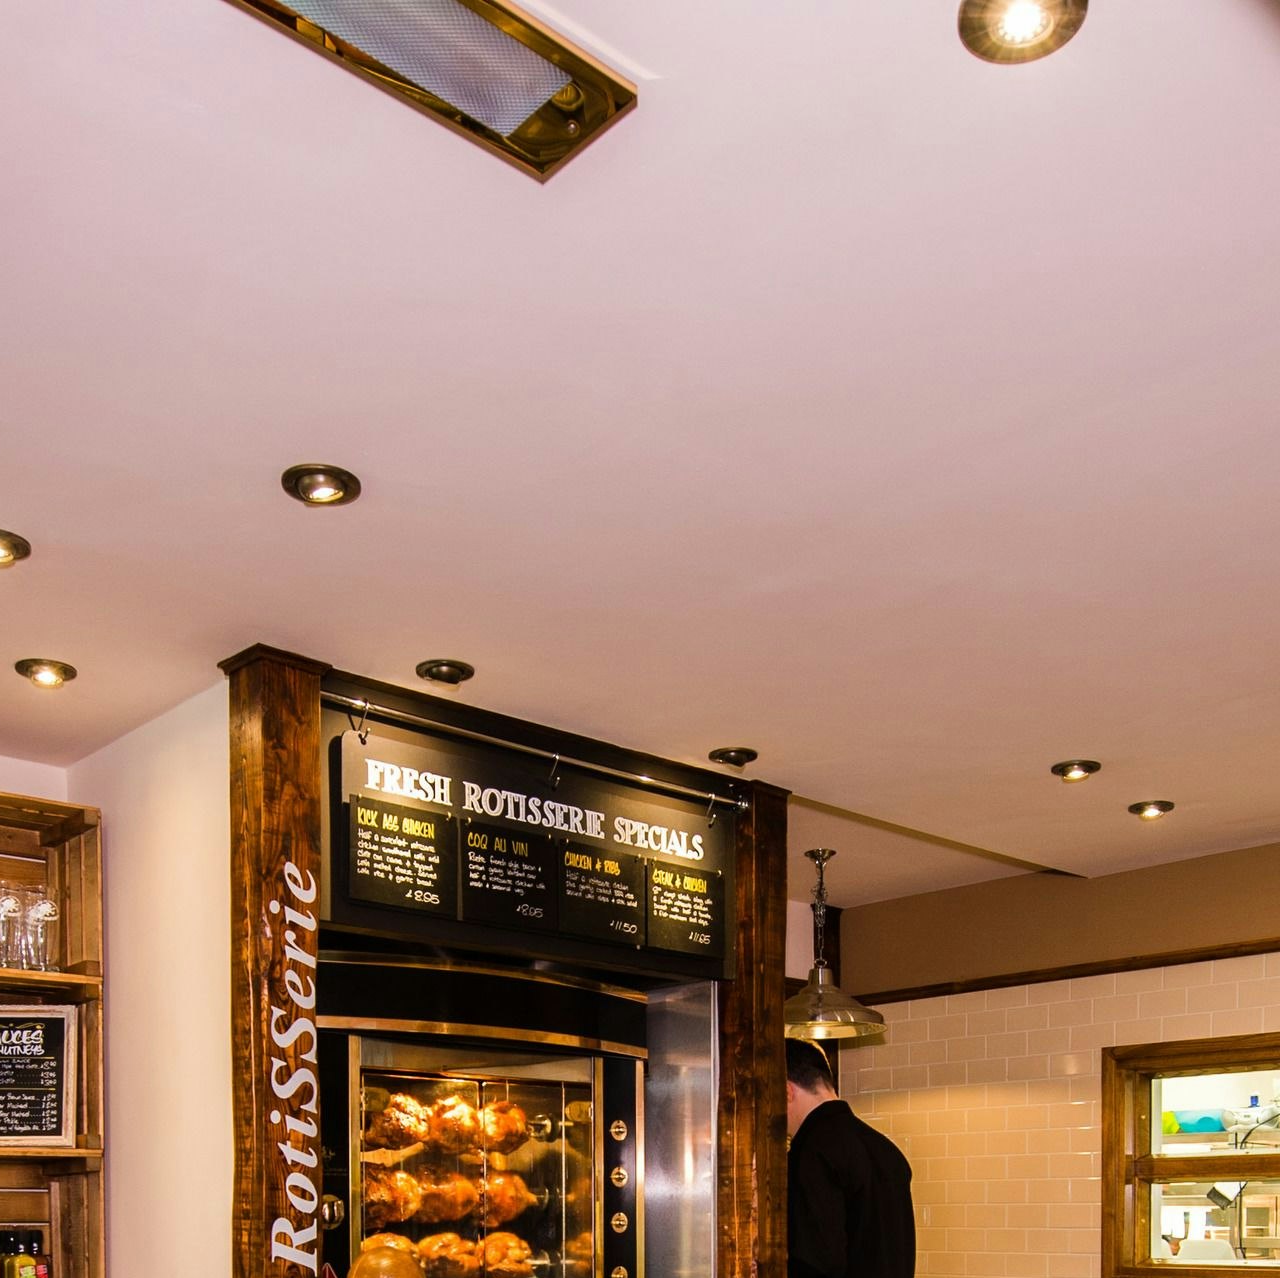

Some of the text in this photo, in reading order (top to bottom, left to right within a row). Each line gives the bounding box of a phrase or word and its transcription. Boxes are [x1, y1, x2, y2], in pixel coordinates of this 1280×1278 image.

[364, 758, 705, 861] FRESH ROTISSERIE SPECIALS
[357, 807, 378, 828] KICK
[402, 817, 434, 839] CHICKEN
[468, 832, 528, 857] COQ AU VIN
[564, 851, 592, 871] CHICKEN
[604, 860, 621, 876] RIBS
[652, 868, 674, 887] STEAK
[683, 876, 707, 893] CHICKEN
